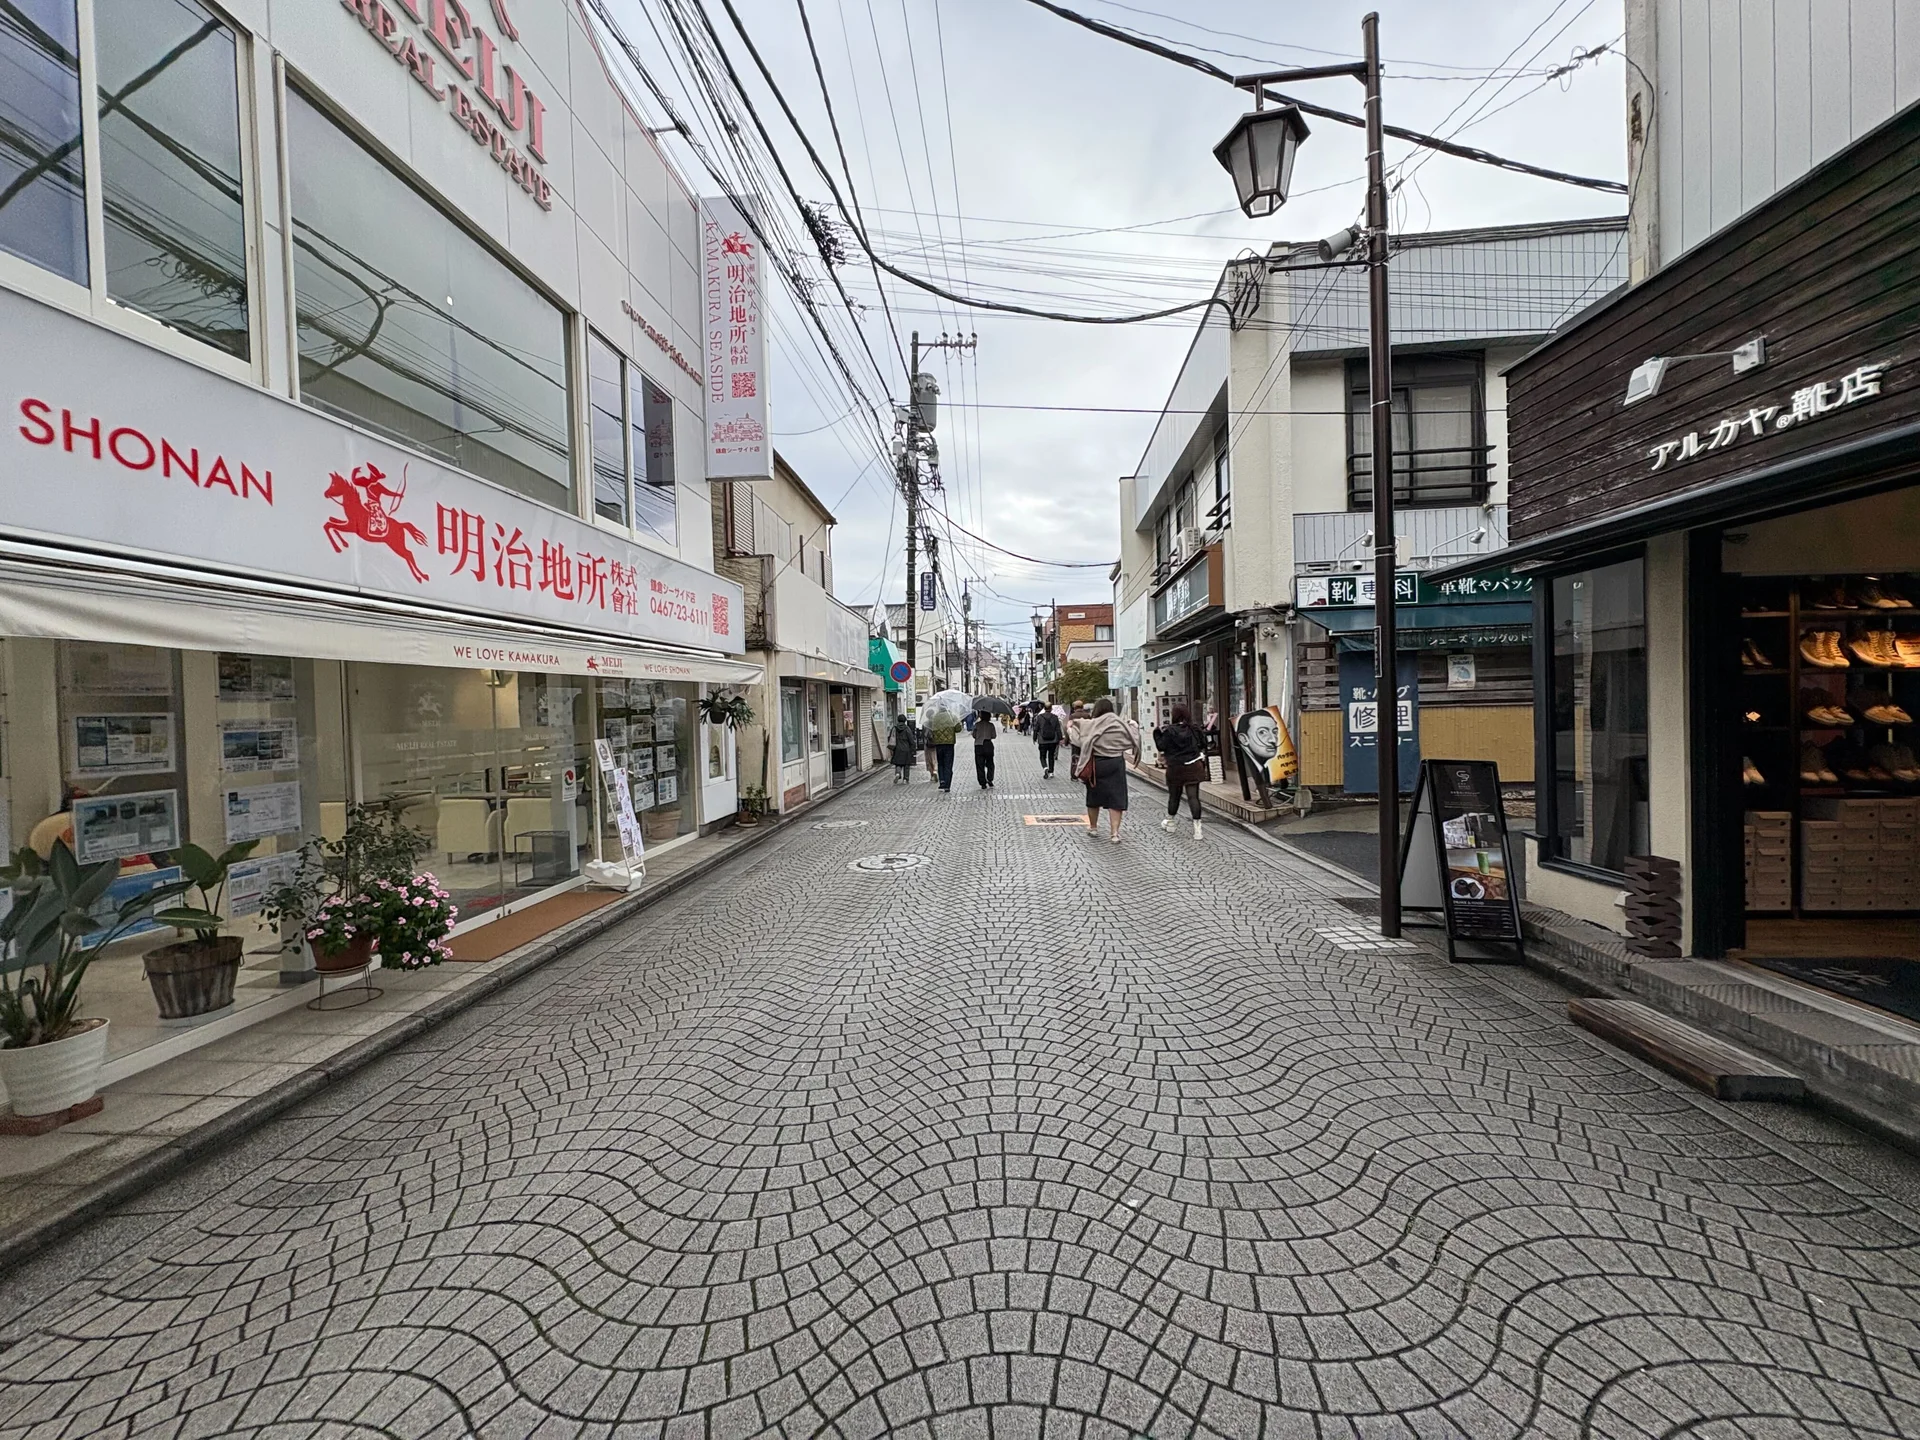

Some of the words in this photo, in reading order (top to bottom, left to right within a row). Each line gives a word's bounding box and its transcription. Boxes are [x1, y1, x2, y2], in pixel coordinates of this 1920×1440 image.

[398, 0, 547, 164] EIJI
[450, 83, 552, 211] ESTATE
[705, 222, 721, 324] KAMAKURA
[727, 264, 747, 345] 明治地所
[709, 330, 724, 403] SEASIDE
[19, 398, 273, 507] SHONAN
[436, 501, 607, 610] 明治地所
[610, 559, 638, 591] 株式
[650, 578, 696, 604] 鎌倉シーサイド店
[650, 597, 708, 626] 0467-23-6111
[453, 645, 472, 659] WE
[476, 648, 504, 661] LOVE
[508, 651, 561, 667] KAMAKURA
[601, 656, 623, 668] MEIJI
[644, 663, 654, 672] WE
[654, 665, 669, 674] LOVE
[669, 665, 691, 676] SHONAN
[1350, 736, 1413, 748] スニー
